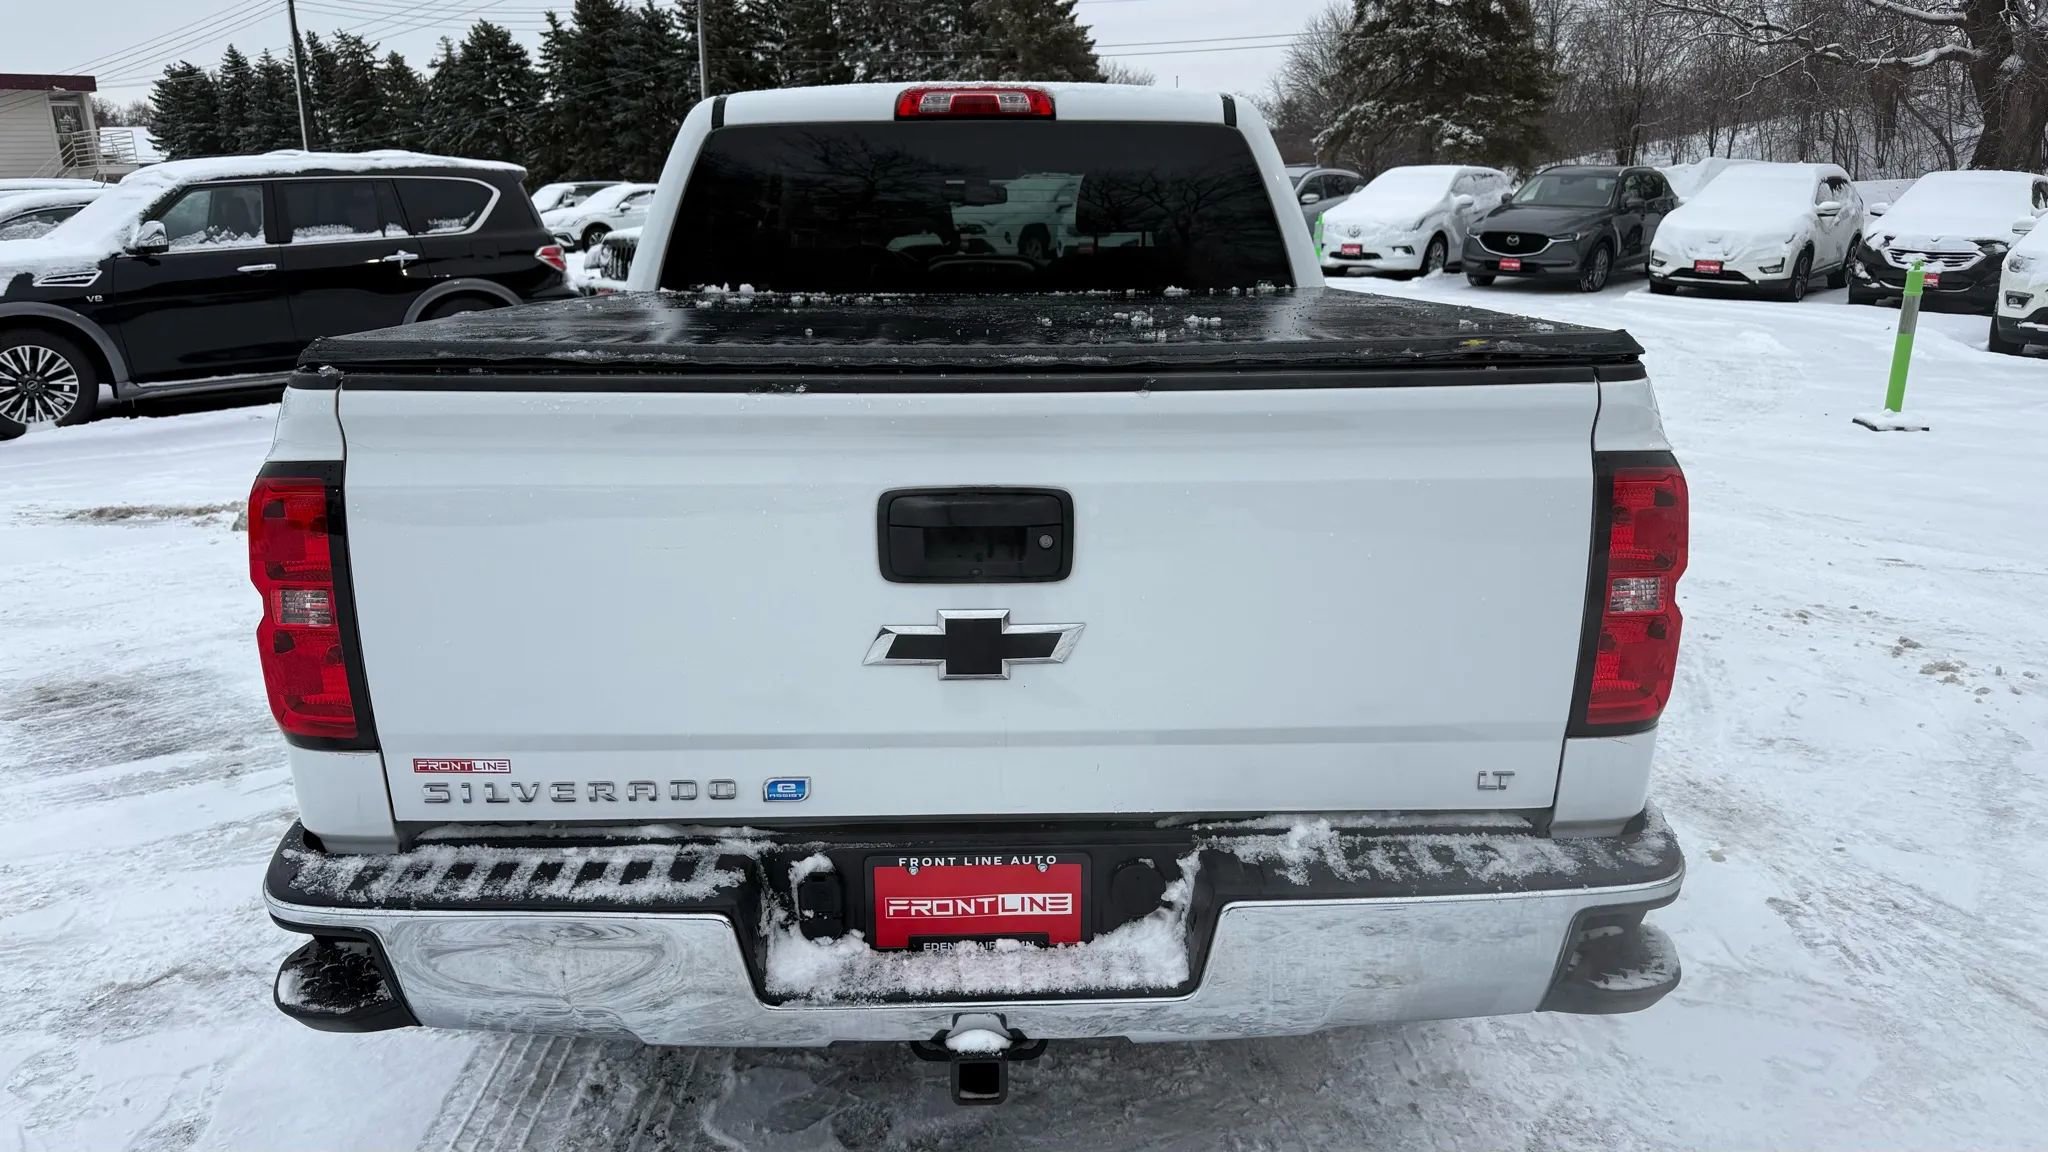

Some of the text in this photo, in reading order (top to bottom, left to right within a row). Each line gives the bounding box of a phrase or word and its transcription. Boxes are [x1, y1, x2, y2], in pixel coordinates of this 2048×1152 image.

[86, 294, 104, 303] V8
[416, 760, 509, 772] FRONTLINE
[1477, 770, 1516, 791] LT
[422, 779, 738, 804] SILVERADO
[898, 854, 1058, 867] FRONT LINE AUTO
[887, 895, 1071, 917] FRONTLINE
